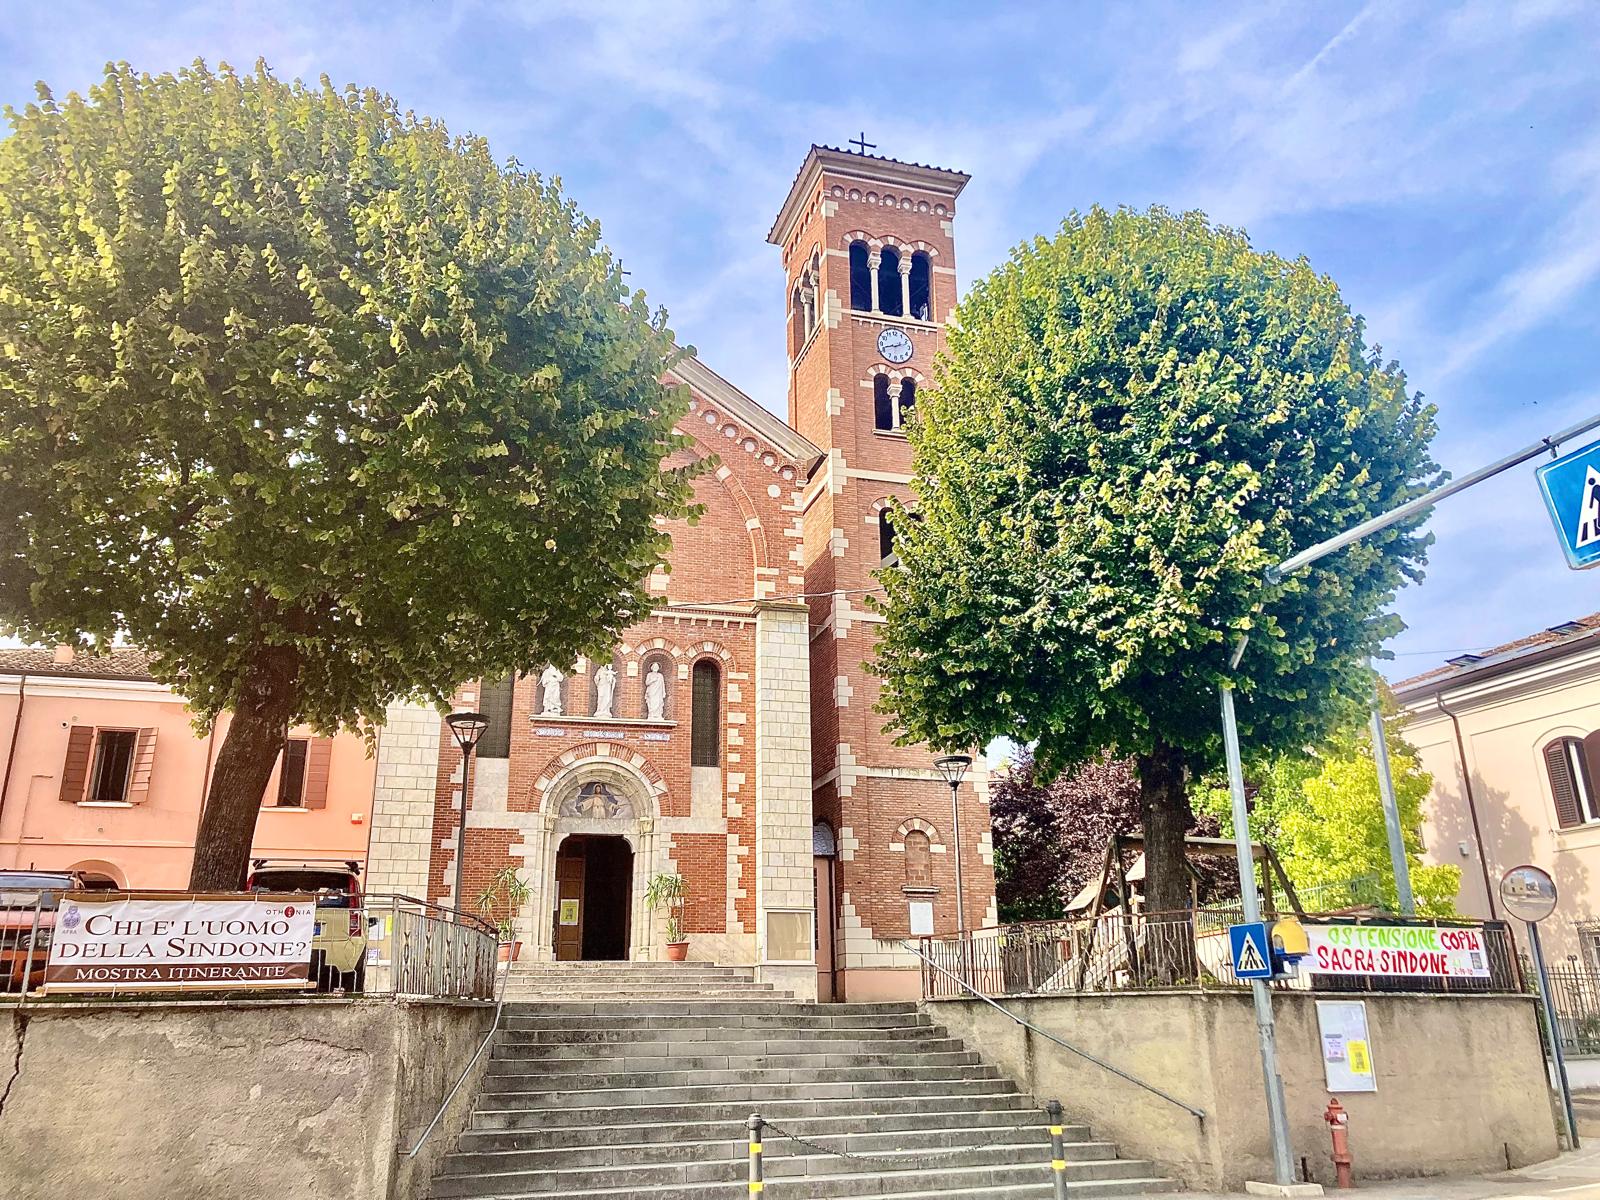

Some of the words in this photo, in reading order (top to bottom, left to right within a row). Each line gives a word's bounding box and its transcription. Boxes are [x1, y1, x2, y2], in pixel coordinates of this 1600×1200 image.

[85, 914, 147, 936] CHI
[153, 920, 176, 935] E'
[184, 920, 290, 935] L'UOMO
[58, 942, 156, 959] DELLA
[166, 937, 307, 958] SINDONE?
[1317, 945, 1376, 972] SACRA
[75, 966, 162, 980] MOSTRA
[168, 966, 286, 979] ITINERANTE
